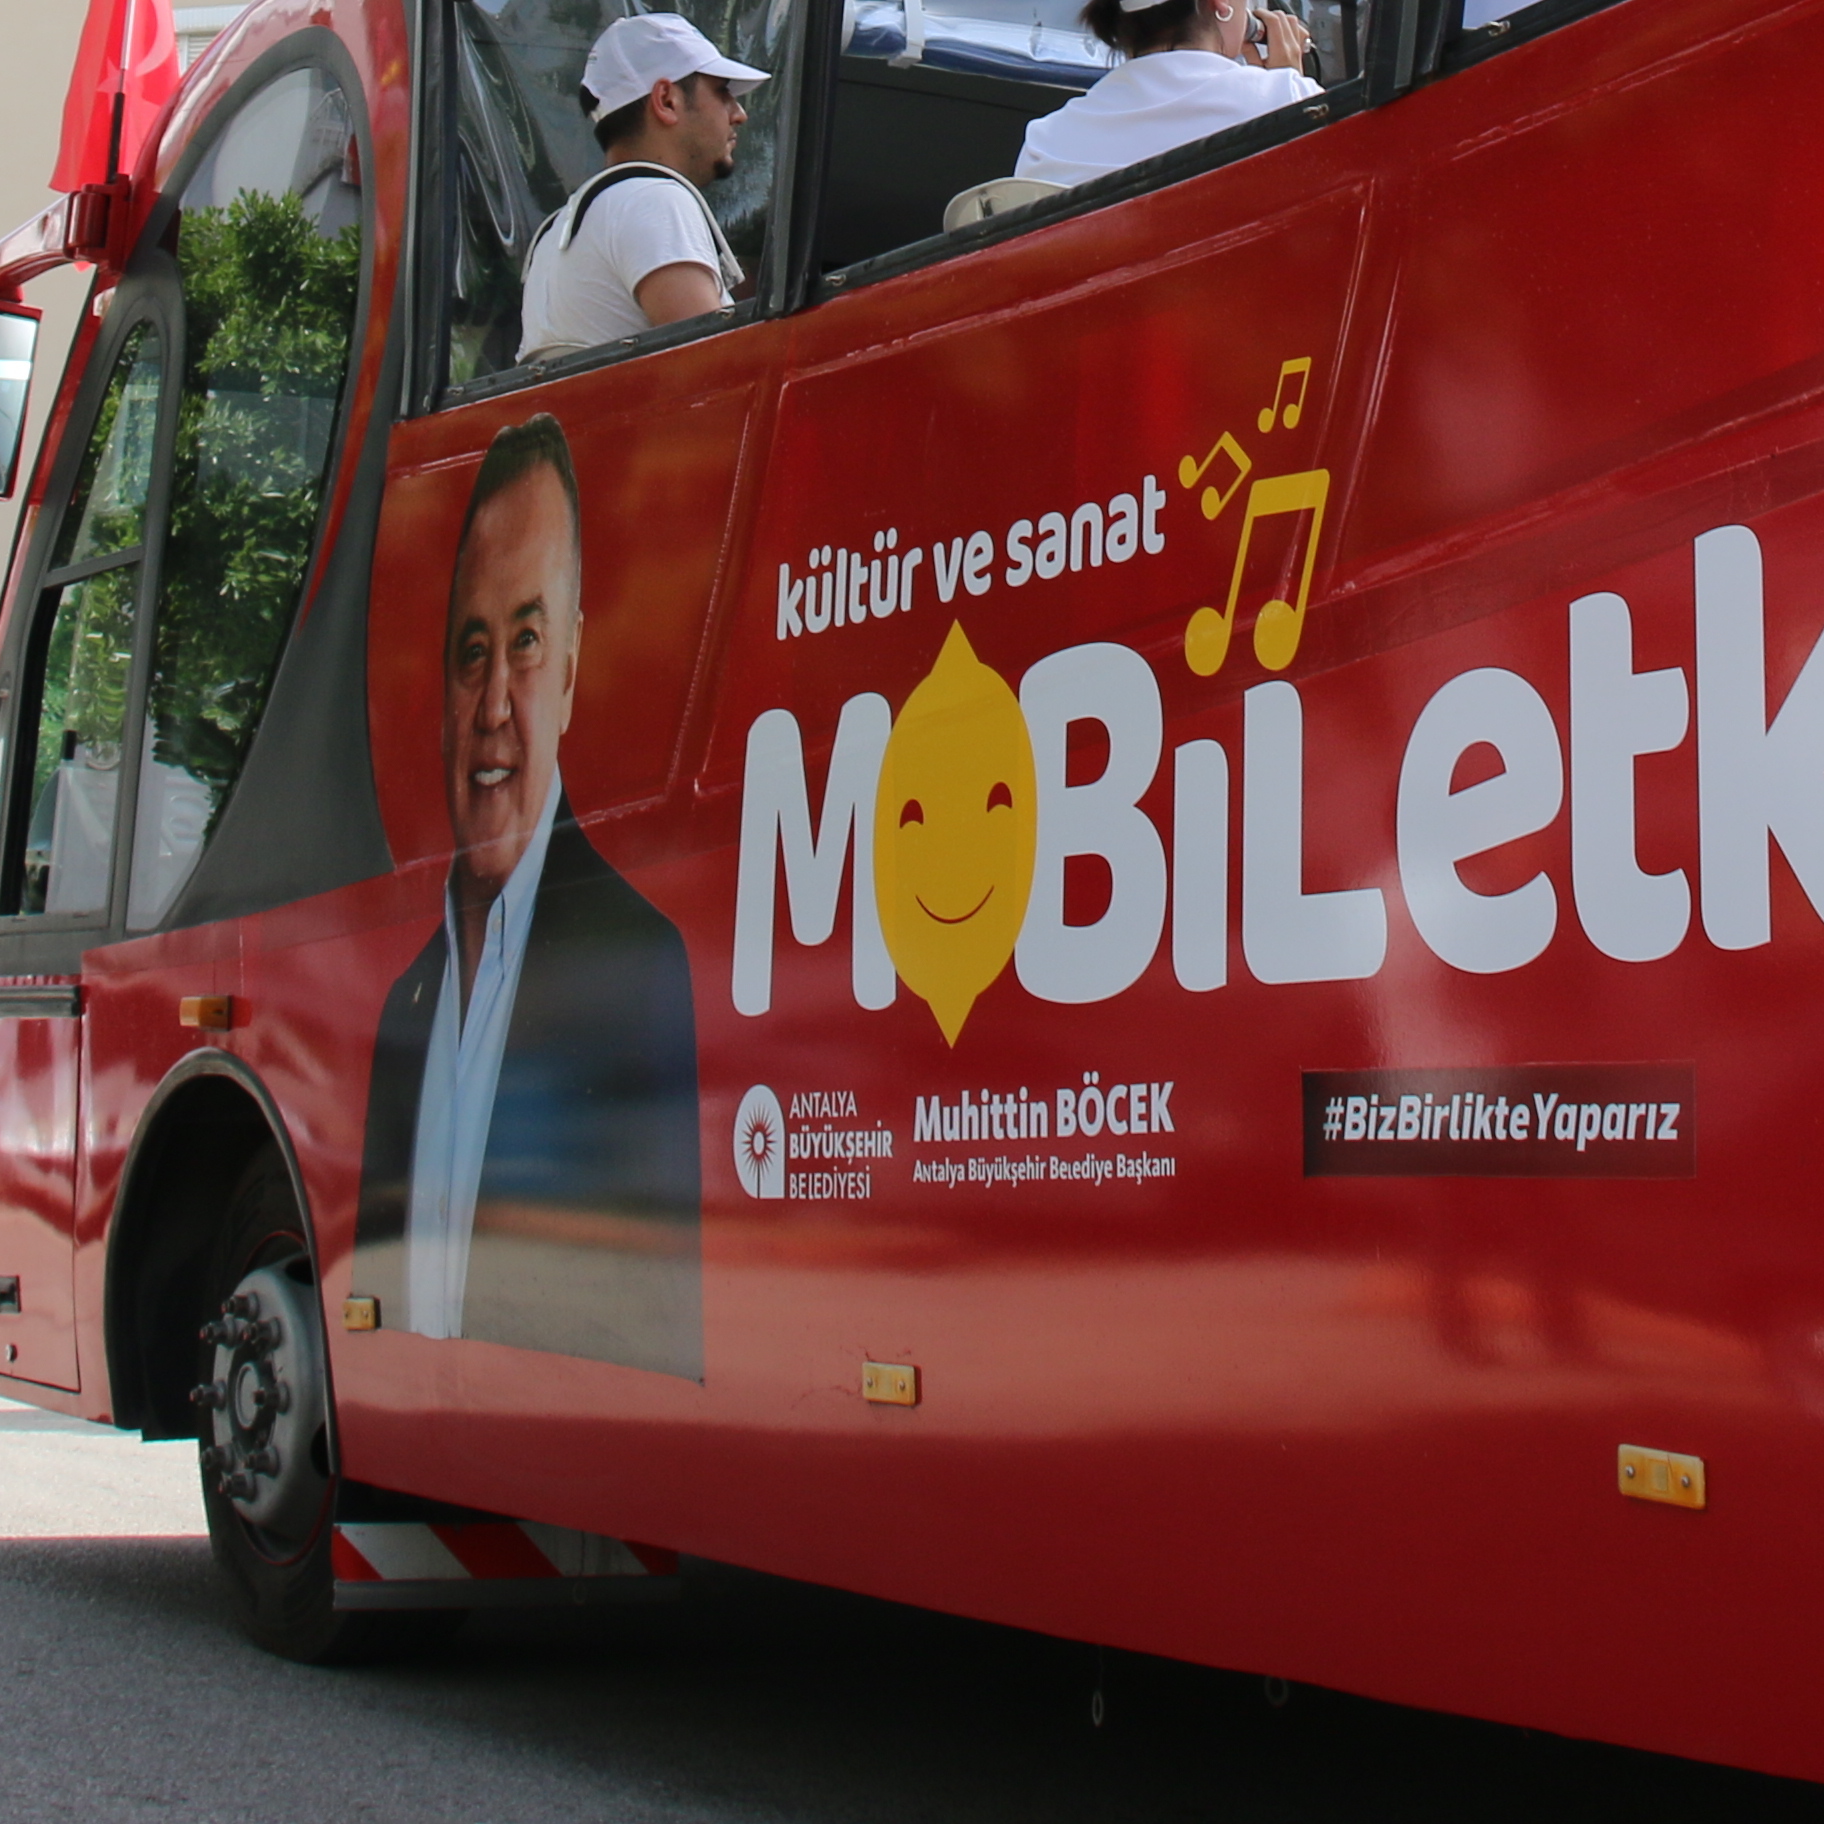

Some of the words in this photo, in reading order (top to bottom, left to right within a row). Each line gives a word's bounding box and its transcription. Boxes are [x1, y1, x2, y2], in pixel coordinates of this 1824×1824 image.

[776, 526, 923, 641] kültür
[933, 530, 994, 603] ve
[1005, 474, 1167, 587] sanat
[789, 1090, 858, 1119] ANTALYA
[913, 1086, 1049, 1143] Muhittin
[1056, 1071, 1175, 1138] BÖCEK
[1323, 1092, 1680, 1152] #BizBirlikteYaparız
[789, 1120, 893, 1166] BÜYÜKŞEHİR
[789, 1165, 871, 1201] BELEDİYESİ
[913, 1158, 966, 1189] Antalya
[968, 1155, 1047, 1188] Büyükşehir
[1049, 1153, 1113, 1186] Belediye
[1116, 1150, 1176, 1185] Başkanı
